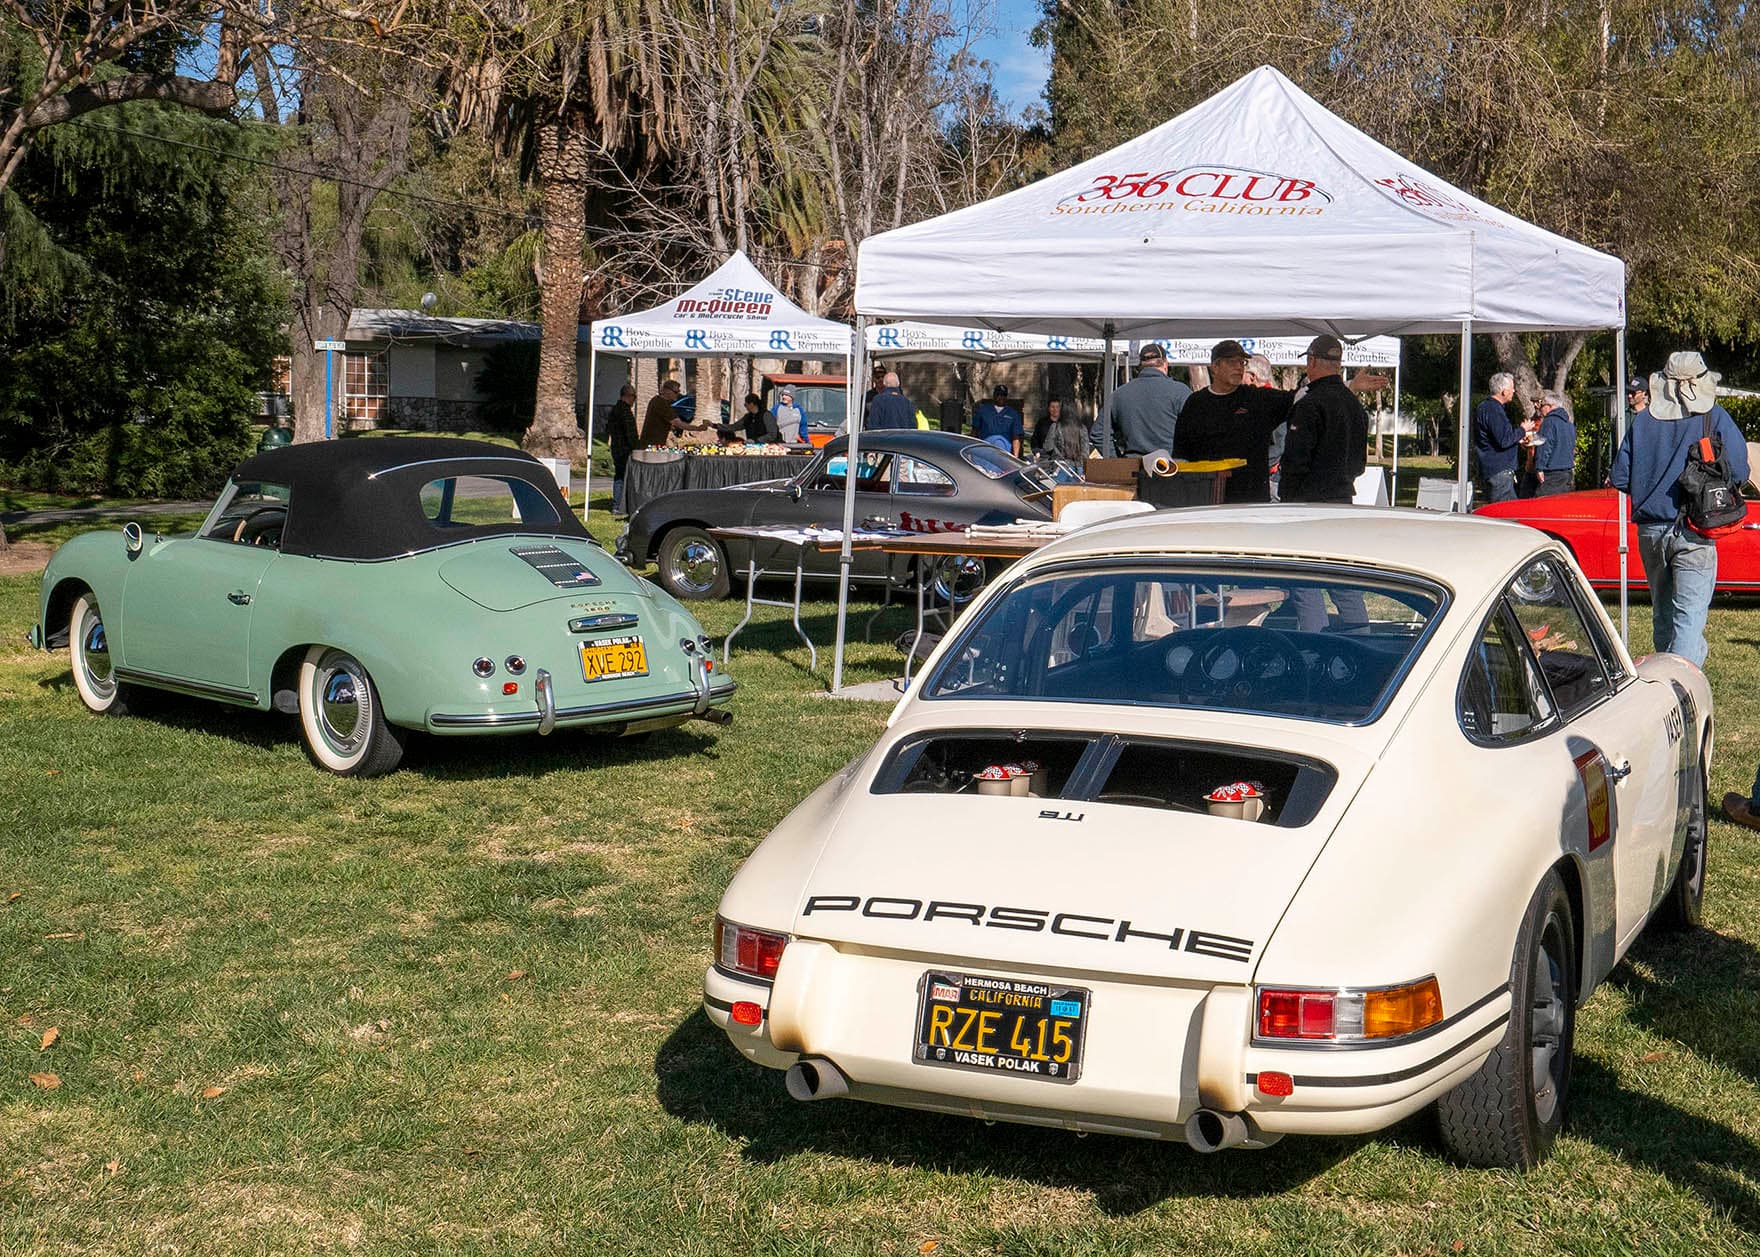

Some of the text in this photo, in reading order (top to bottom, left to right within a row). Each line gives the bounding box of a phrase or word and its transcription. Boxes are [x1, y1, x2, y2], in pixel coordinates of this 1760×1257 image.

[1077, 171, 1316, 202] 356 CLUB
[1050, 200, 1323, 216] Southern California
[901, 328, 927, 340] Boys
[986, 331, 1012, 342] Boys
[630, 338, 673, 349] Republic
[714, 340, 757, 351] Republic
[798, 341, 841, 351] Republic
[906, 338, 950, 350] Republic
[991, 341, 1034, 350] Republic
[1258, 340, 1283, 351] Boys
[1179, 349, 1210, 361] Repub
[1263, 350, 1299, 362] Republi
[1346, 351, 1390, 363] Republic
[587, 650, 644, 676] XVE 292
[802, 895, 1254, 963] PORSCHE
[934, 985, 959, 999] MAR
[964, 977, 1047, 995] HERMOSA BEACH
[969, 989, 1041, 1009] CALIFORNIA
[928, 1004, 1073, 1063] RZE 415
[954, 1051, 1040, 1073] VASEK POLAK
